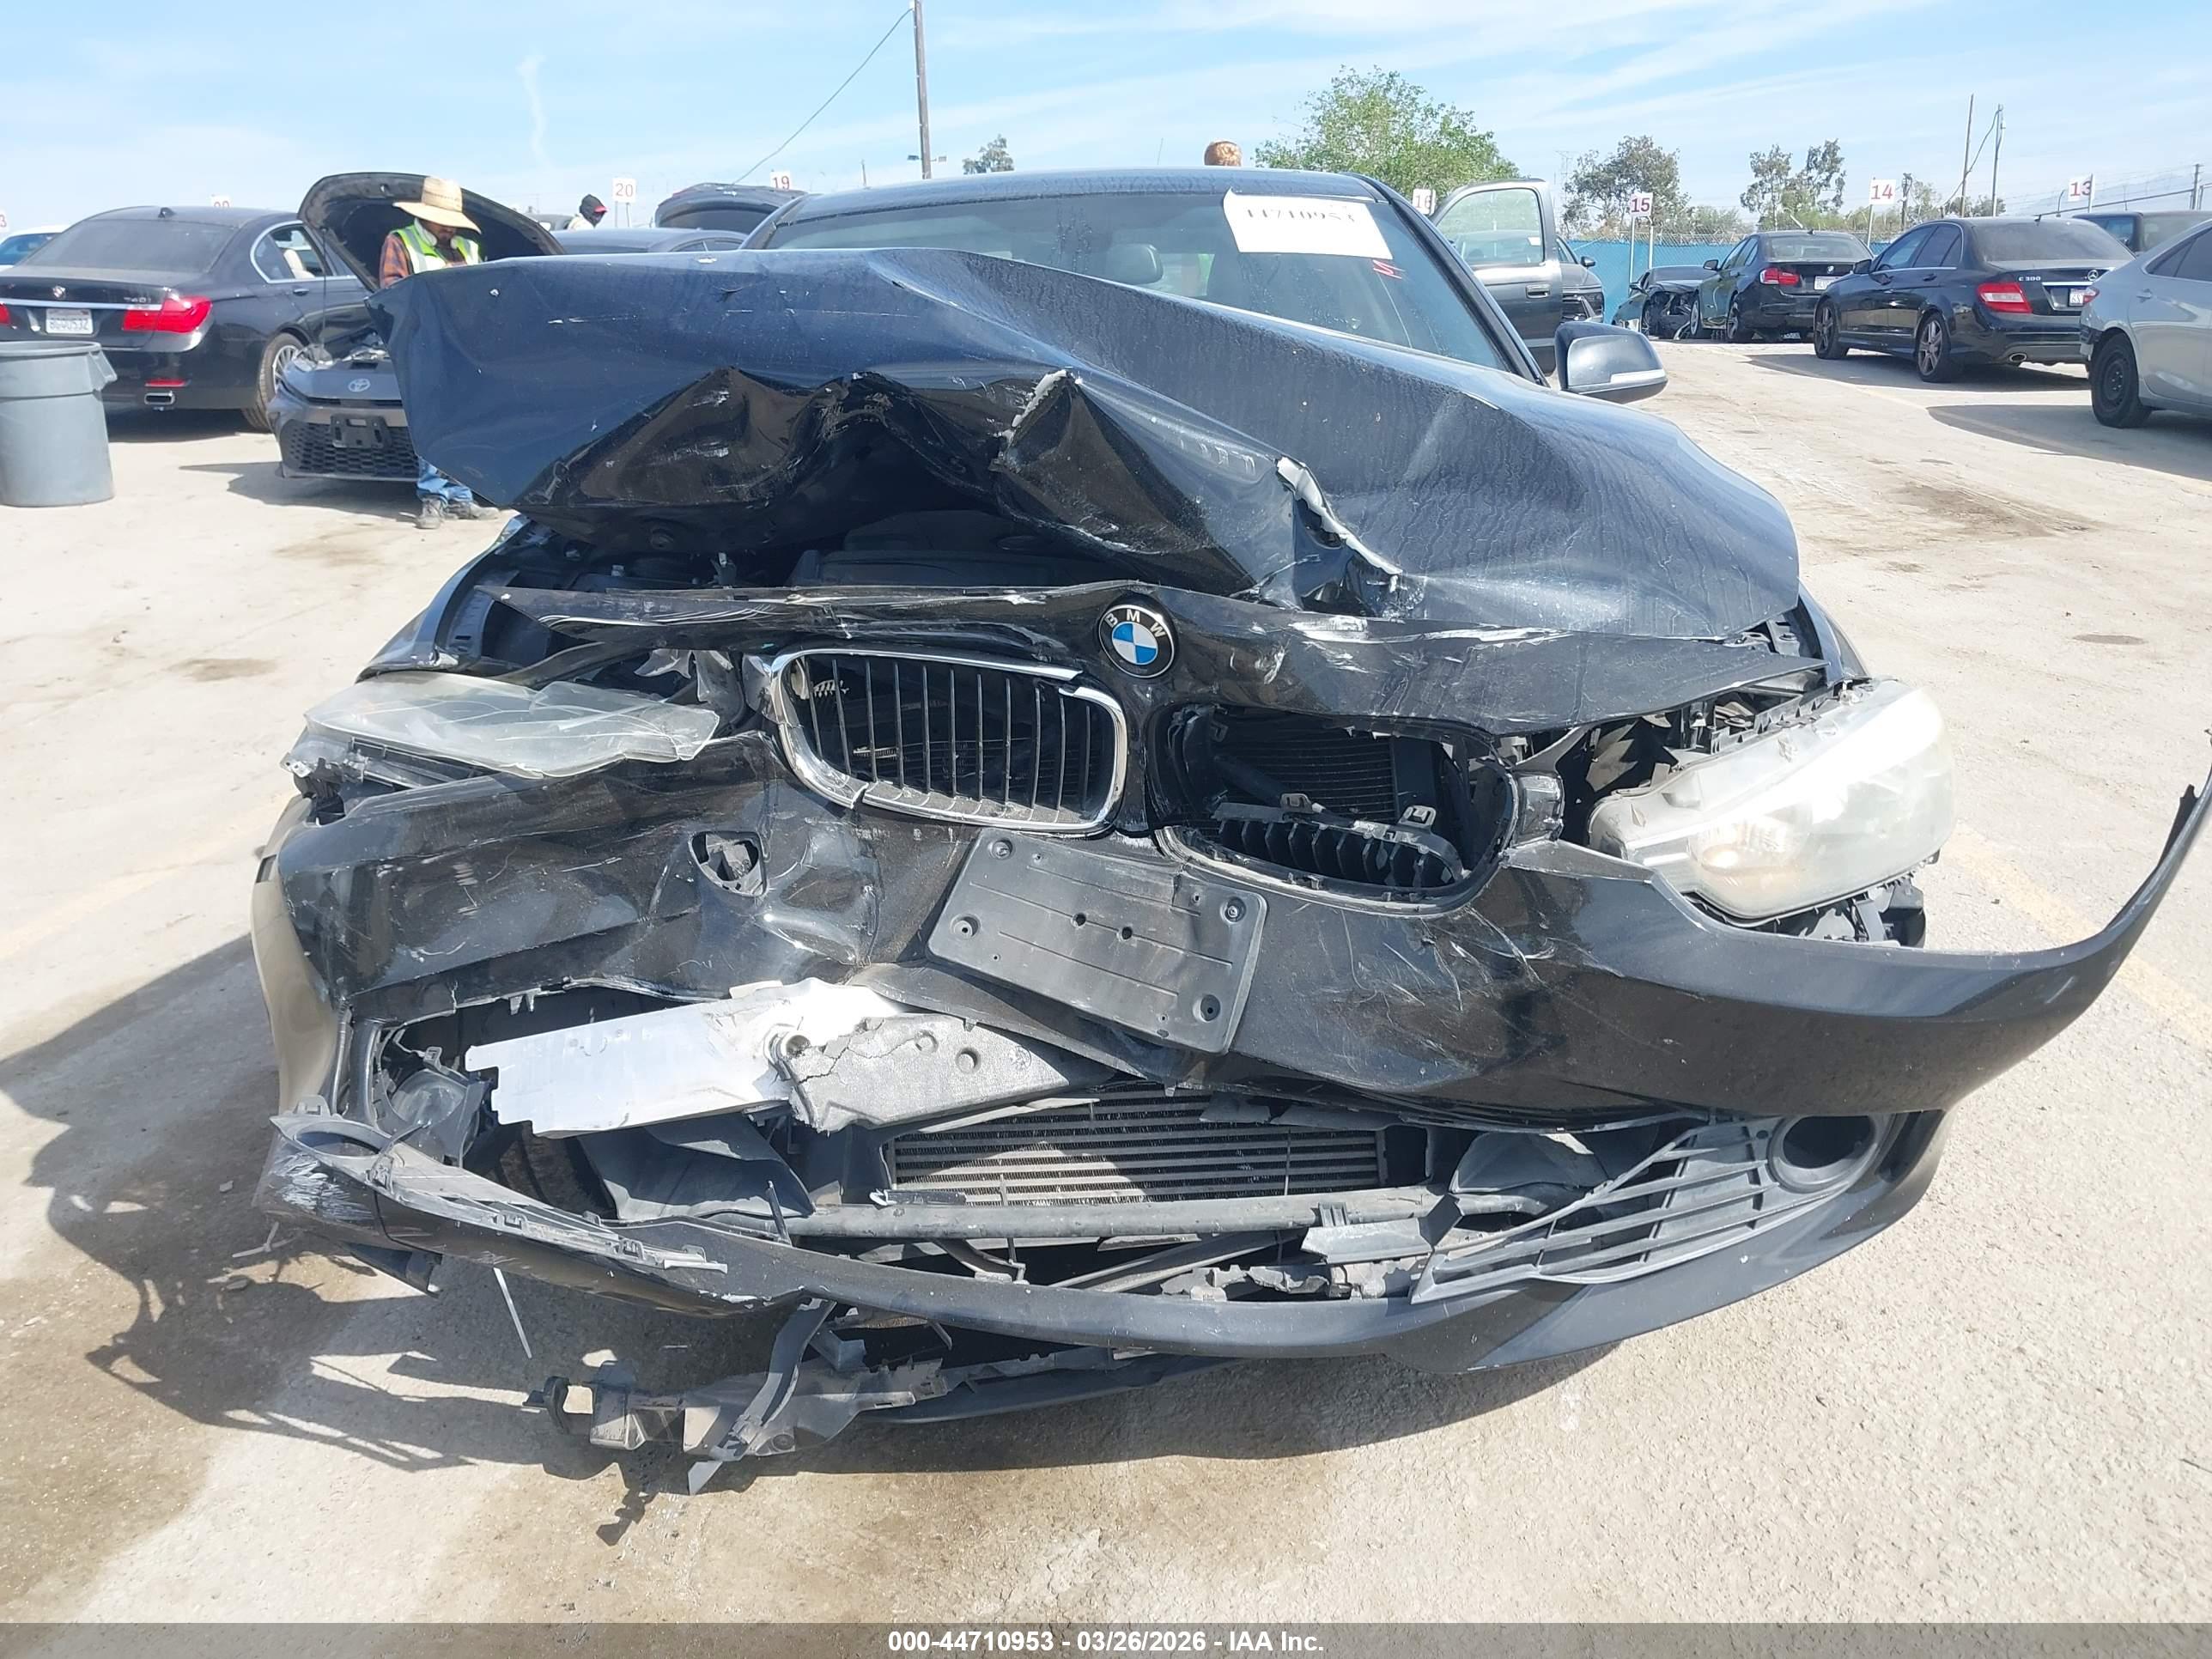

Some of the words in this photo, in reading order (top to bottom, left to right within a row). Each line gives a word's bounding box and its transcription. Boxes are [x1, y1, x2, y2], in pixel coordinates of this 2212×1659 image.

[615, 182, 634, 198] 20
[773, 175, 790, 191] 19
[2070, 180, 2092, 197] 13
[1871, 184, 1893, 199] 14
[1632, 198, 1650, 213] 15
[1104, 608, 1168, 639] BMW
